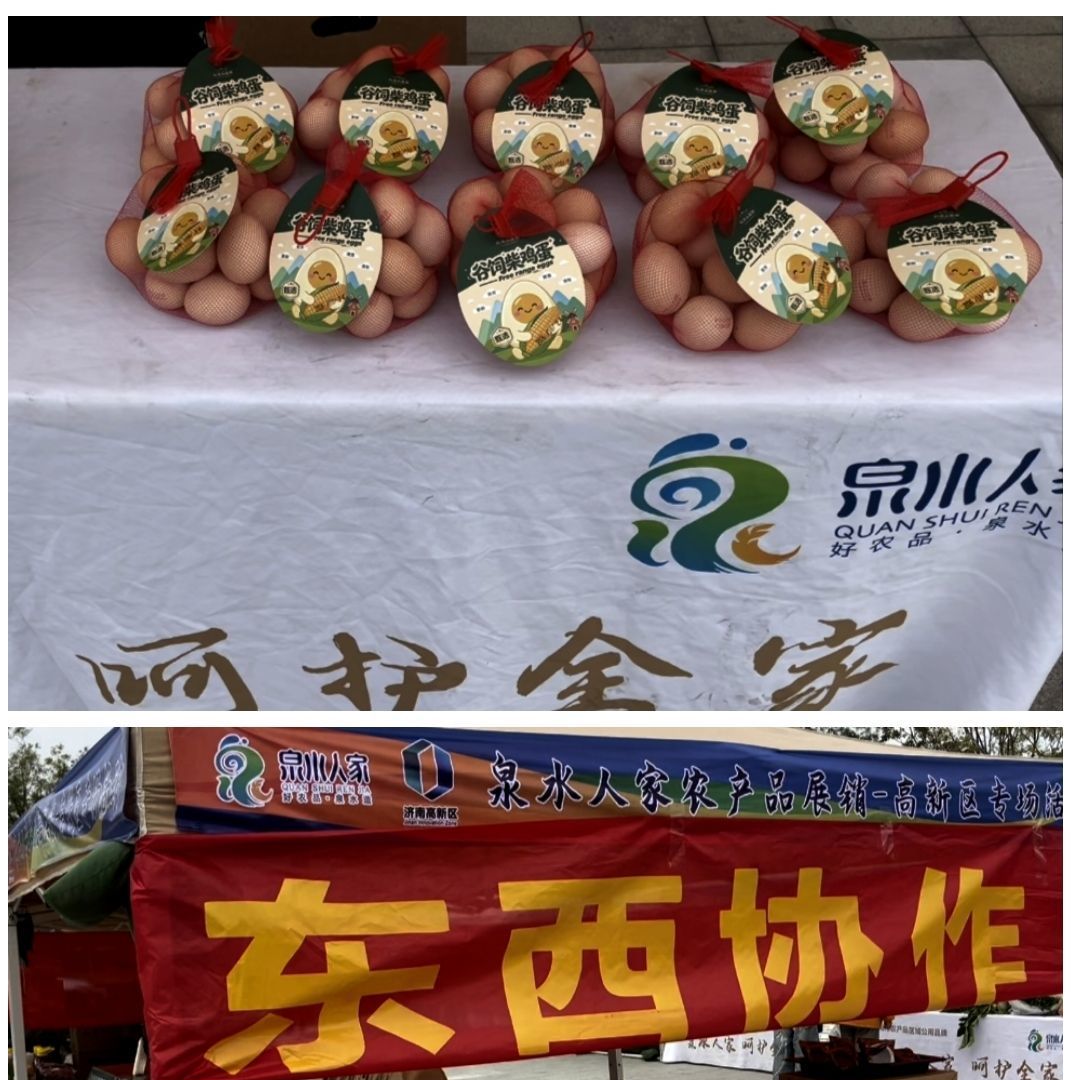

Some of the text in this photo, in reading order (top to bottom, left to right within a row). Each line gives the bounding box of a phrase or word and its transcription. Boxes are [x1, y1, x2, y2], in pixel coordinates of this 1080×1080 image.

[192, 74, 264, 105] 谷饲柴鸡蛋
[359, 85, 435, 108] 谷饲柴鸡蛋
[663, 95, 746, 120] 谷饲柴鸡蛋
[733, 200, 794, 263] 谷饲柴鸡蛋
[903, 220, 998, 243] 谷饲柴鸡蛋
[470, 237, 555, 282] 谷饲柴鸡蛋
[836, 448, 1063, 518] 泉水人
[833, 500, 1053, 539] QUAN SHUI REN
[277, 748, 371, 784] 泉水人家
[489, 750, 1063, 822] 泉水人家农产品展销-高新区专场活
[404, 805, 458, 819] 济南高新区
[203, 866, 1029, 1077] 东西协作
